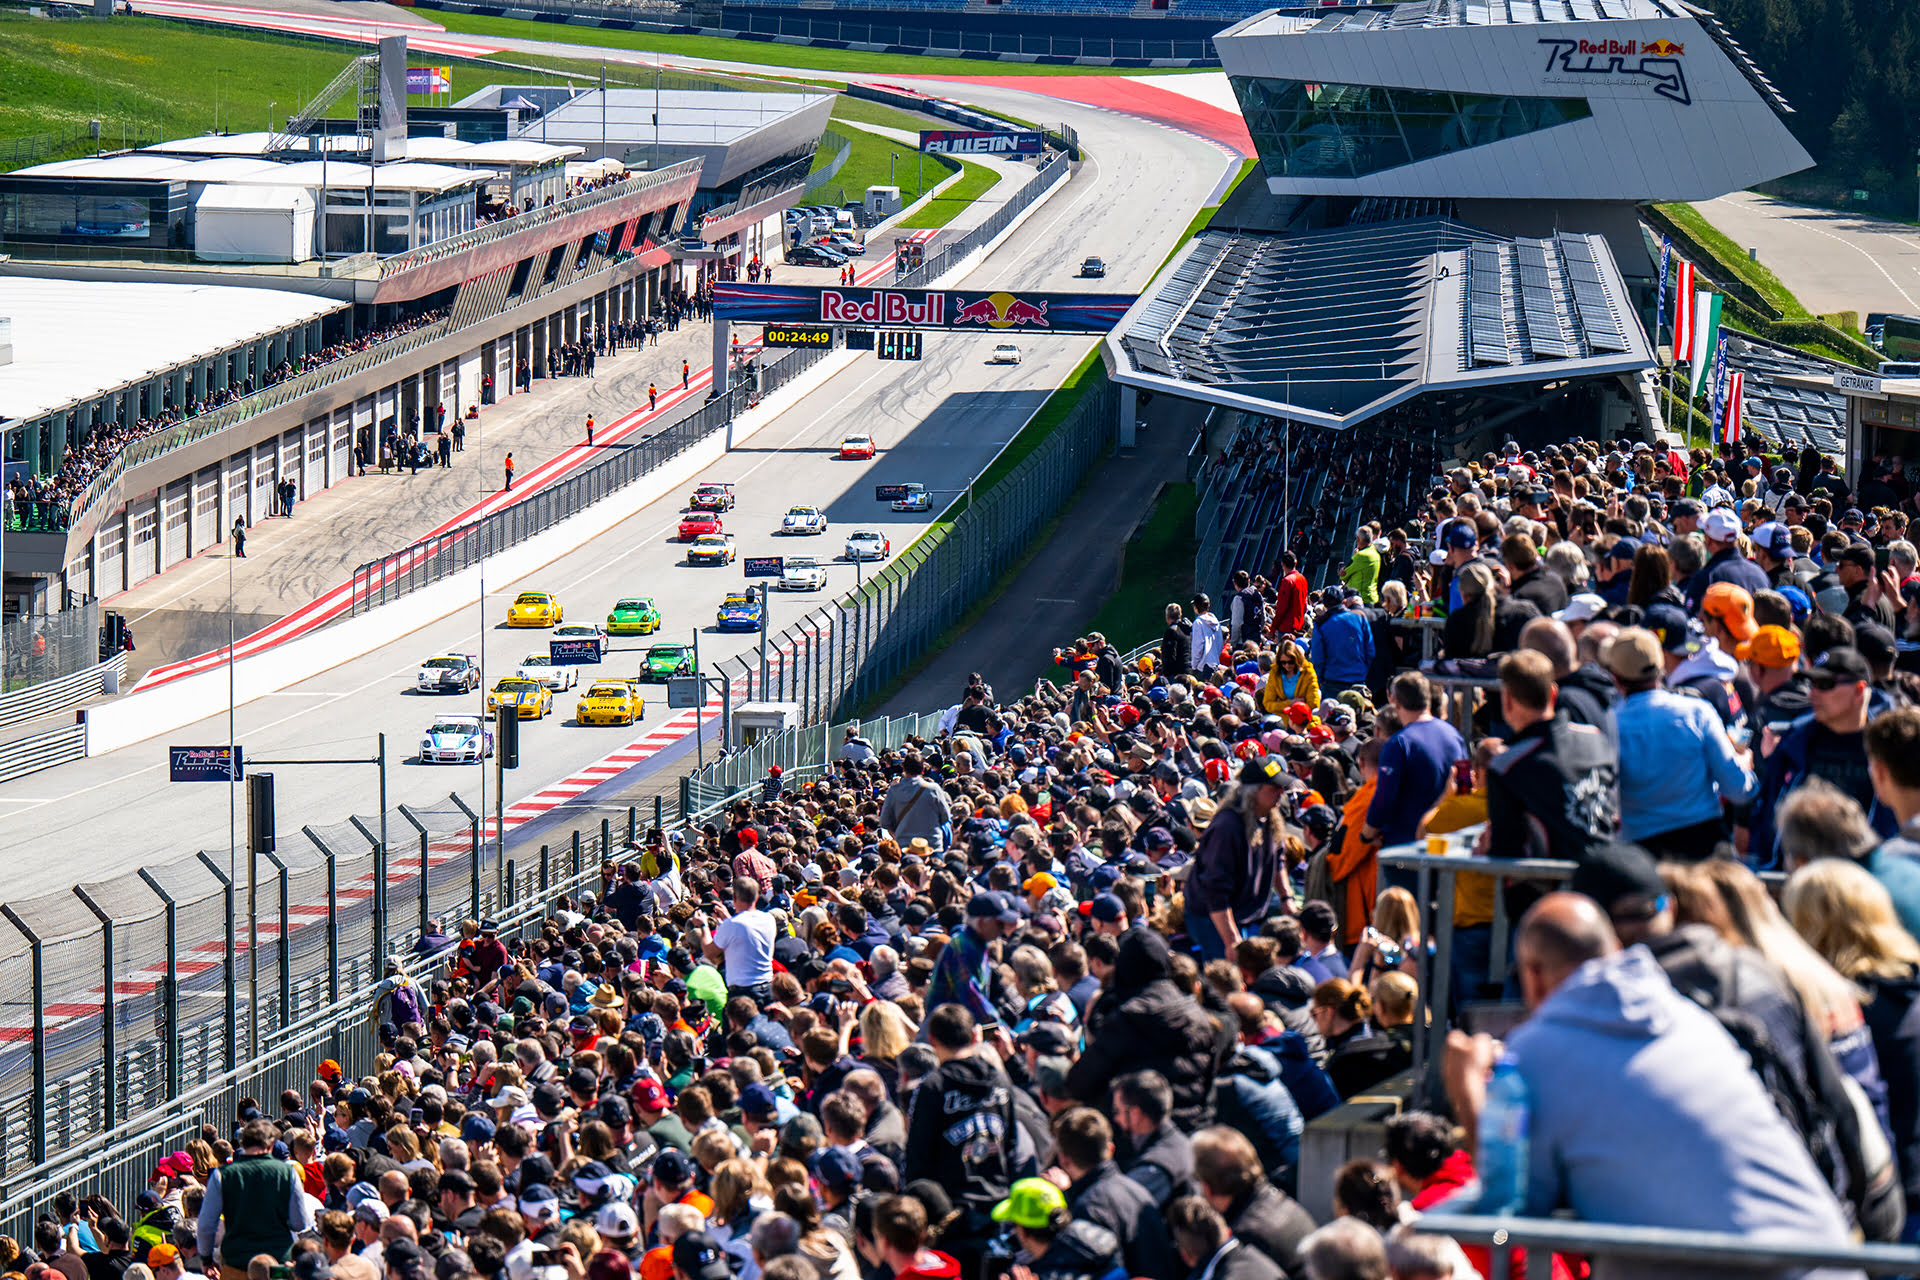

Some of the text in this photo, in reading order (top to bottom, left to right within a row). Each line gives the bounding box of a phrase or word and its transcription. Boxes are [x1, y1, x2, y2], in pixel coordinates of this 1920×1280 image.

[1579, 39, 1636, 55] Red Bull
[1538, 39, 1691, 105] Ring
[821, 290, 945, 325] Red Bull
[768, 331, 830, 343] 00:24:49
[1840, 376, 1874, 391] GETRÄNKE
